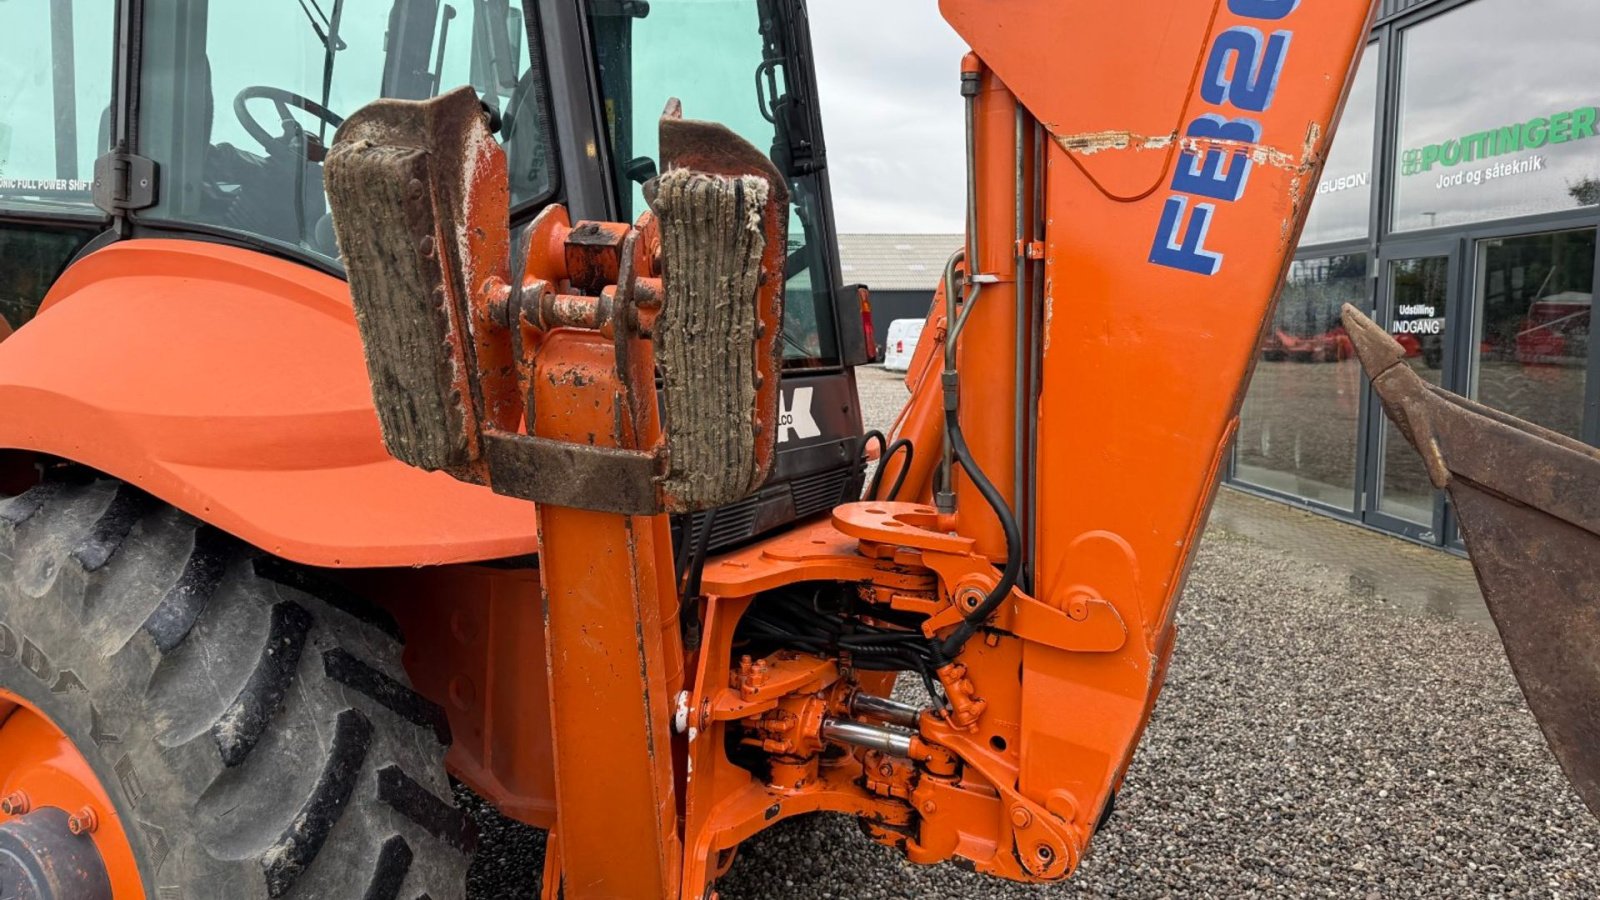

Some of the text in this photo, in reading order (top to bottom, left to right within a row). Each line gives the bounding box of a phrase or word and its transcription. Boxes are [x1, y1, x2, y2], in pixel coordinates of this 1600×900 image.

[1148, 0, 1301, 276] FB2
[1436, 156, 1541, 189] Jord og såteknik
[17, 180, 36, 189] FULL
[38, 180, 67, 190] POWER
[68, 179, 93, 191] SHIFT
[1317, 172, 1366, 193] GUSON
[1399, 304, 1435, 317] Udstilling
[1393, 320, 1440, 334] INDGANG
